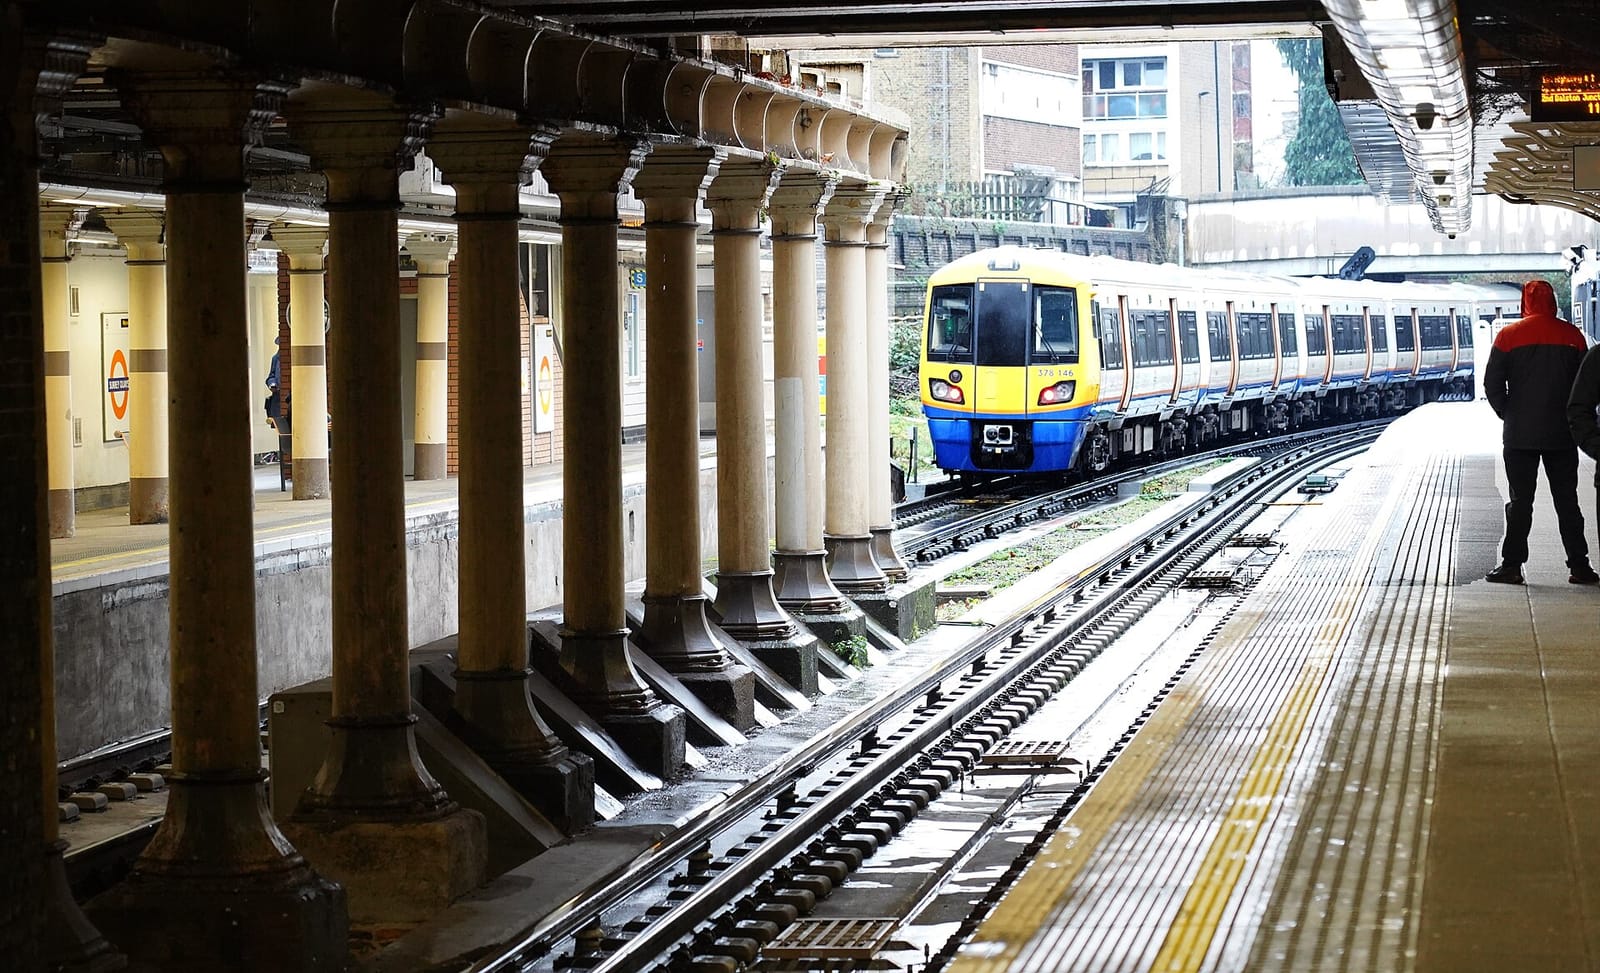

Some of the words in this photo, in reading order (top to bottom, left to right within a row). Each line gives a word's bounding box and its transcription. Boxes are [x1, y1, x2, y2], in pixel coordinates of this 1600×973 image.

[636, 273, 643, 283] S
[1038, 369, 1054, 377] 378
[1058, 369, 1074, 377] 146
